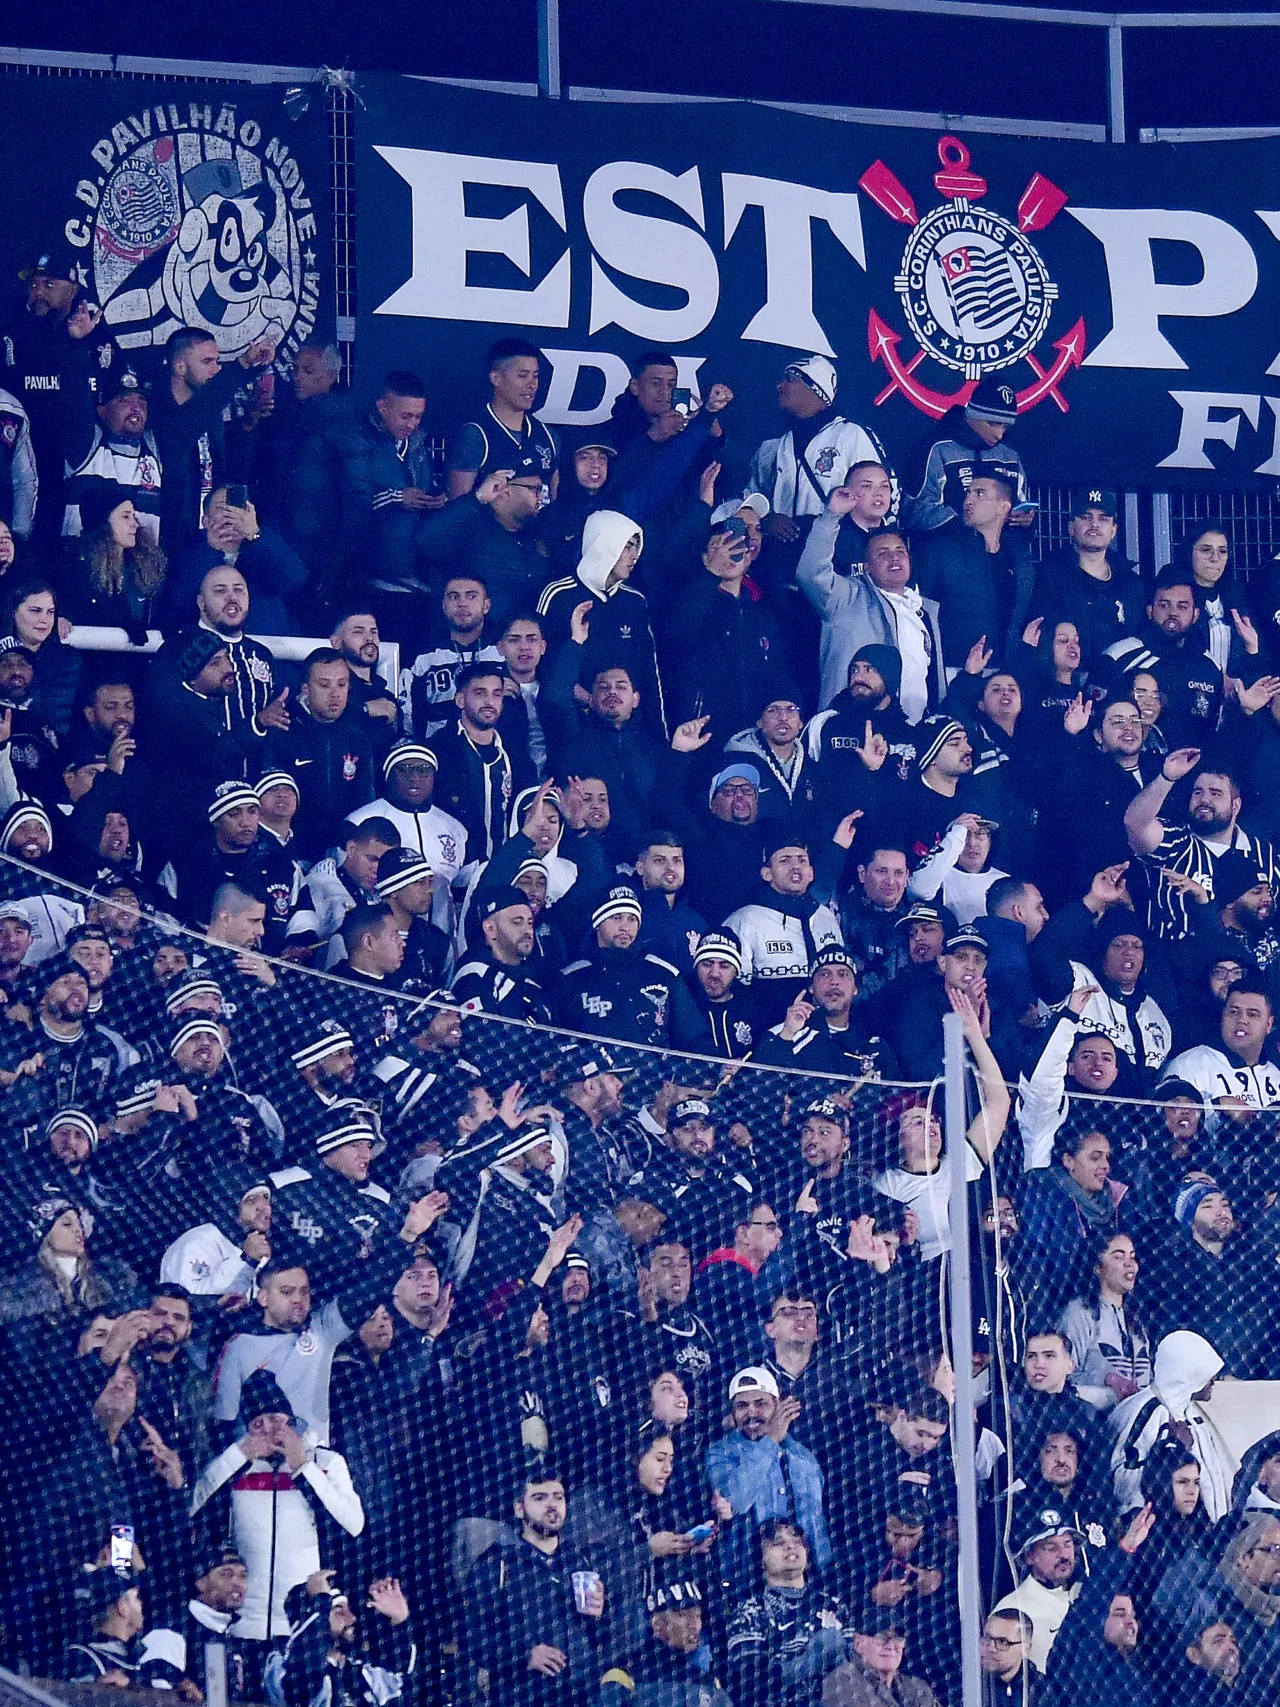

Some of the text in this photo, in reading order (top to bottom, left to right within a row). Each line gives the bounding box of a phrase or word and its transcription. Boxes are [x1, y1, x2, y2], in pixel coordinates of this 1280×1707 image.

[90, 102, 262, 174] PAVILHÃO
[264, 136, 317, 240] NOVE
[129, 232, 152, 242] 1910
[910, 214, 1042, 340] S.C. CORINTHIANS PAULISTA
[954, 343, 1000, 361] 1910
[24, 375, 60, 390] PAVILH
[766, 940, 793, 954] 1969
